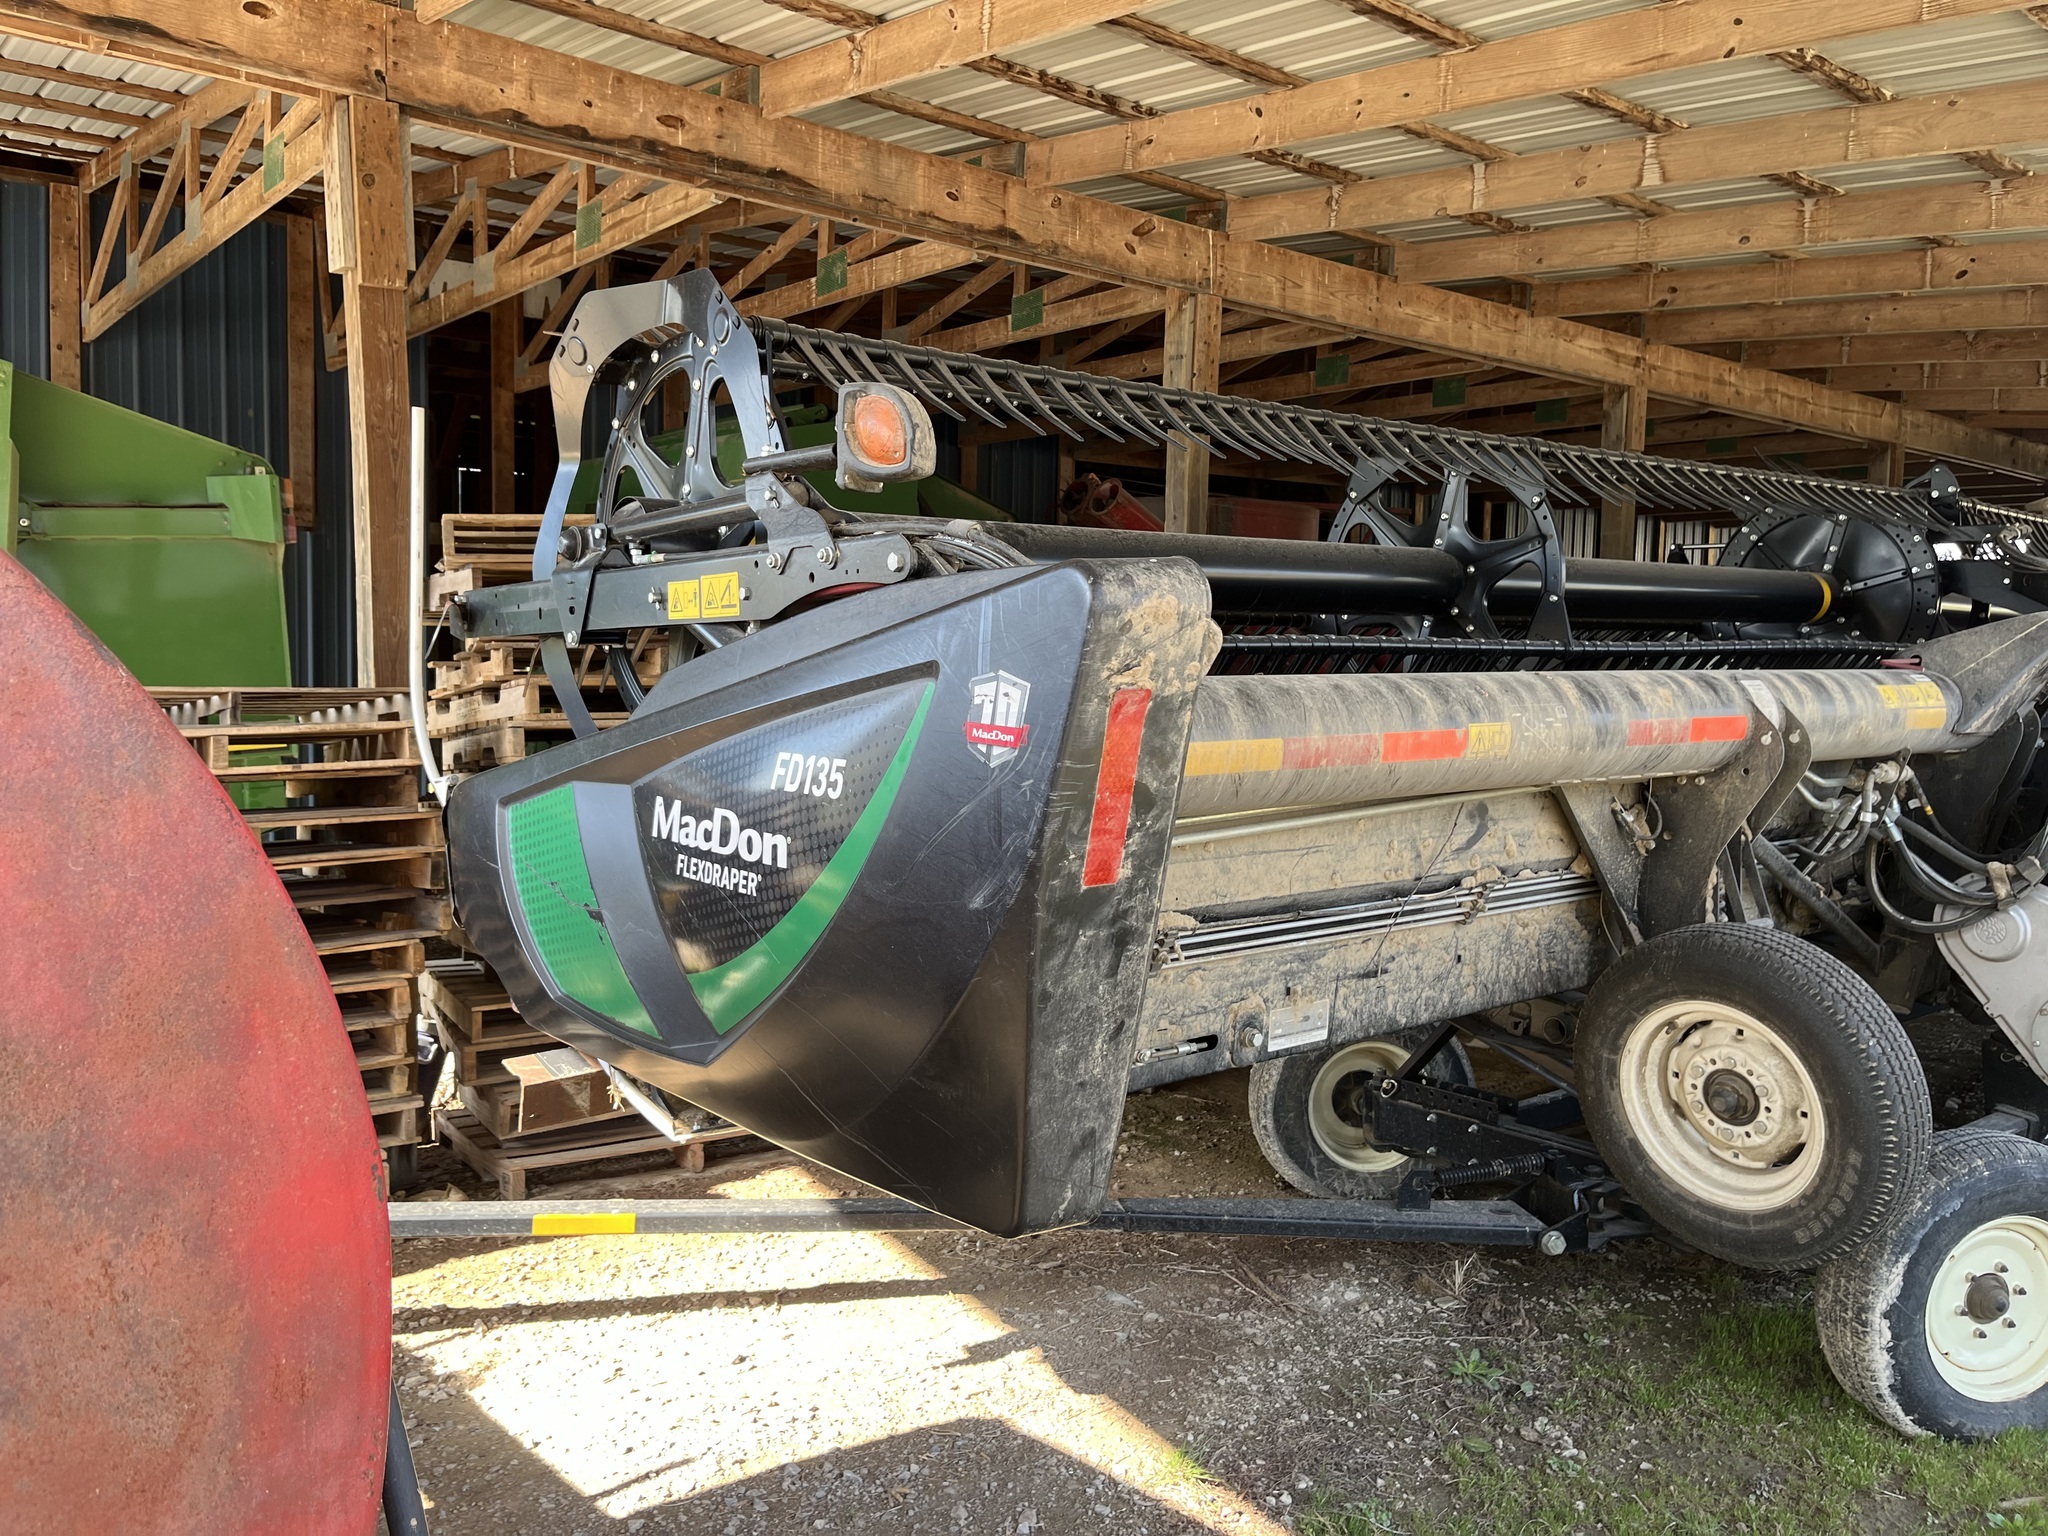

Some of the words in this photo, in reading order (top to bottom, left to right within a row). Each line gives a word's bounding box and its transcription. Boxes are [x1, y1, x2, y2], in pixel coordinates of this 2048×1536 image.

[971, 727, 1015, 743] MacDon
[770, 752, 847, 800] FD135
[651, 795, 788, 869] MacDon
